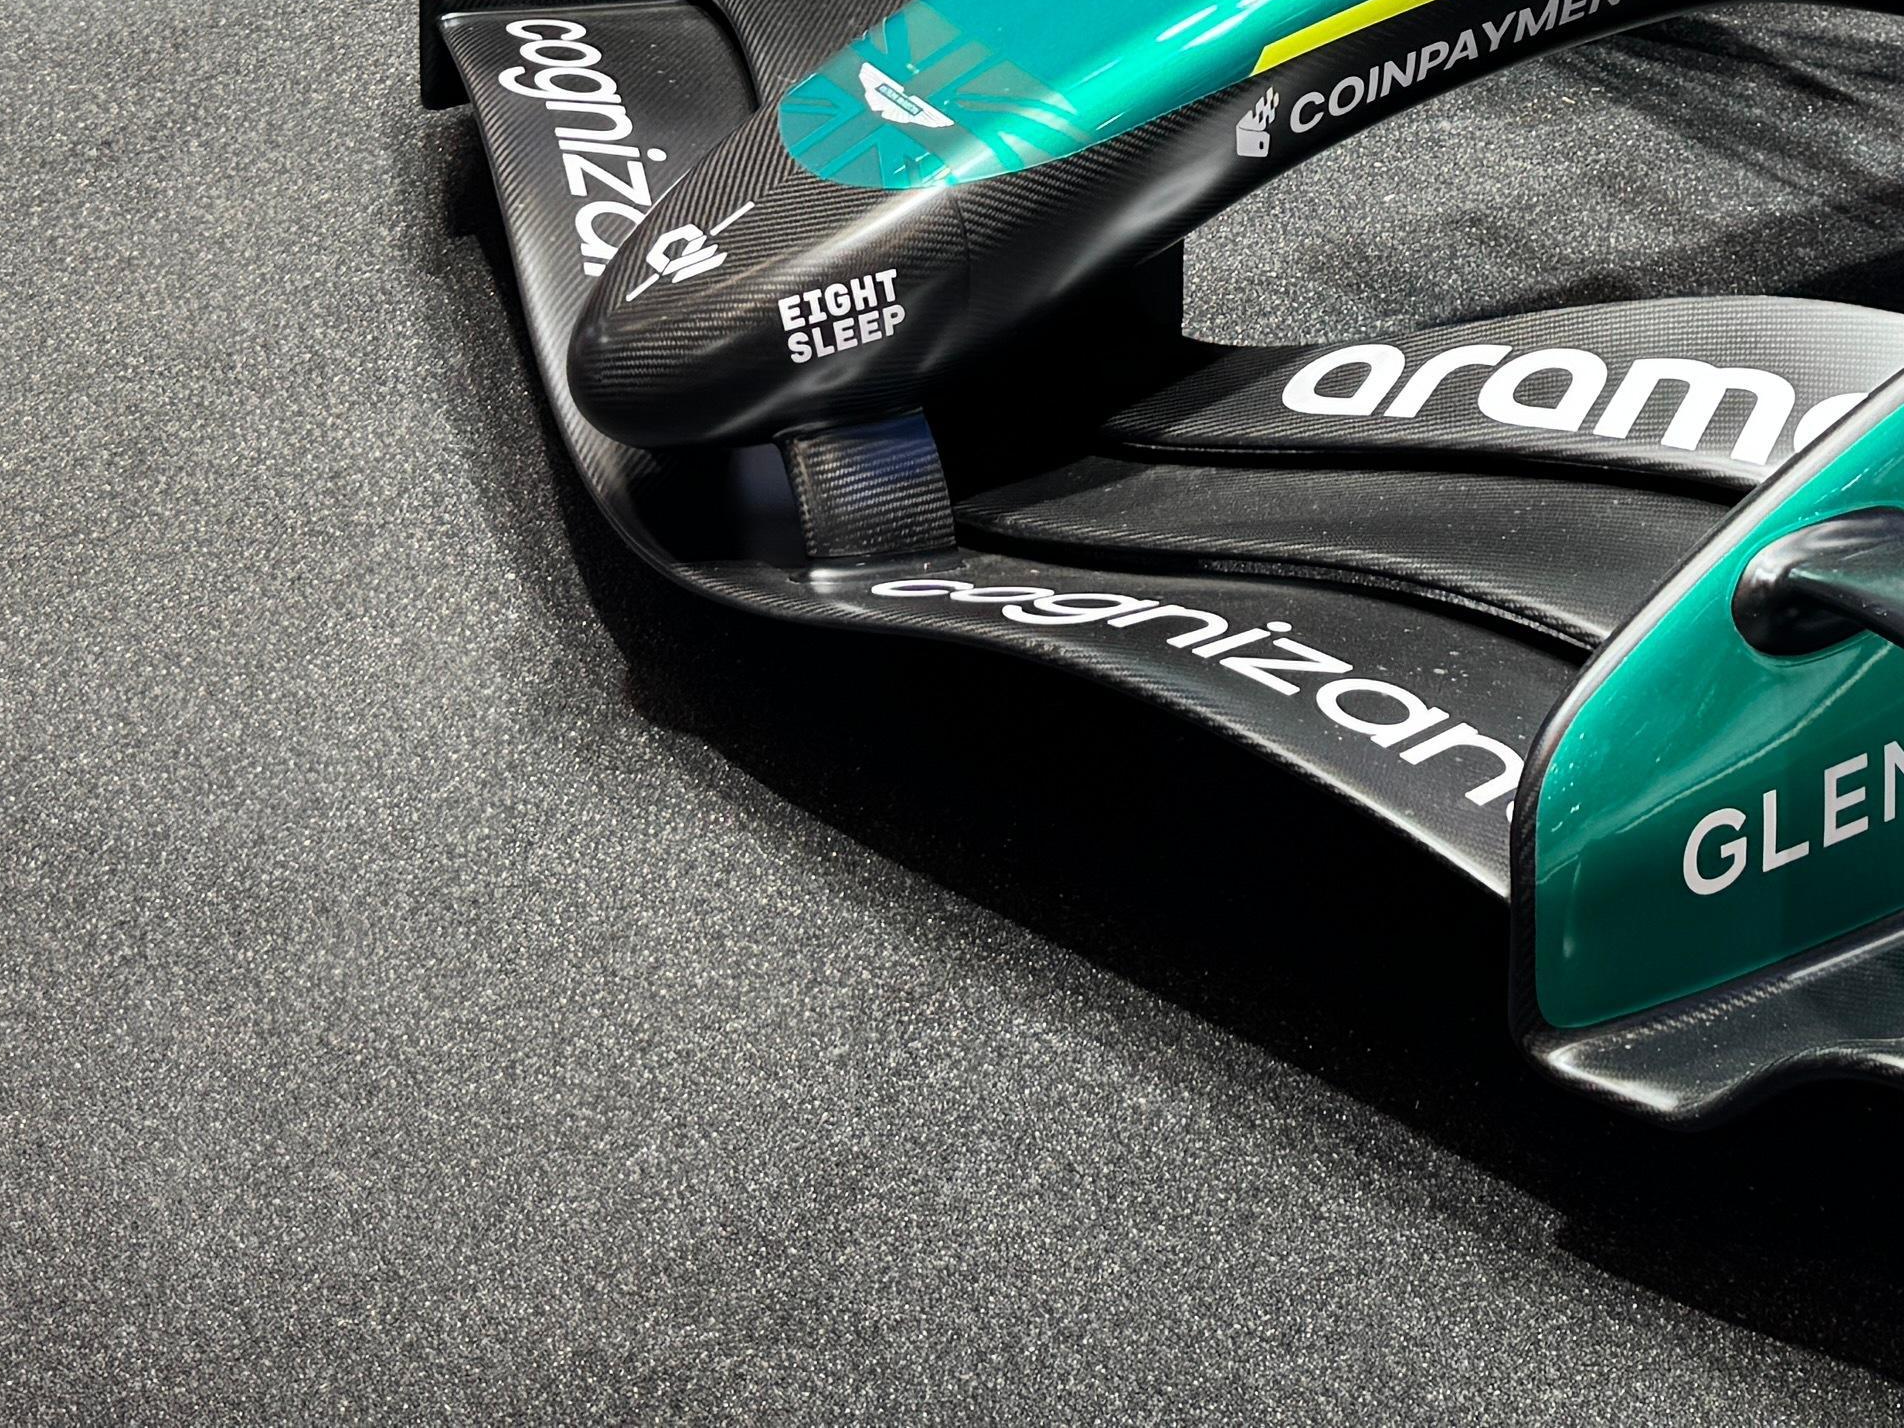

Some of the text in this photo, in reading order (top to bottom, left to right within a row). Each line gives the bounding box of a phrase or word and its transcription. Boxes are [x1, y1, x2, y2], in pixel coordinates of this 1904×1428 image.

[497, 17, 669, 278] cogniza
[777, 268, 900, 331] EIGHT
[787, 300, 908, 365] SLEEP
[870, 575, 1526, 820] cognizan
